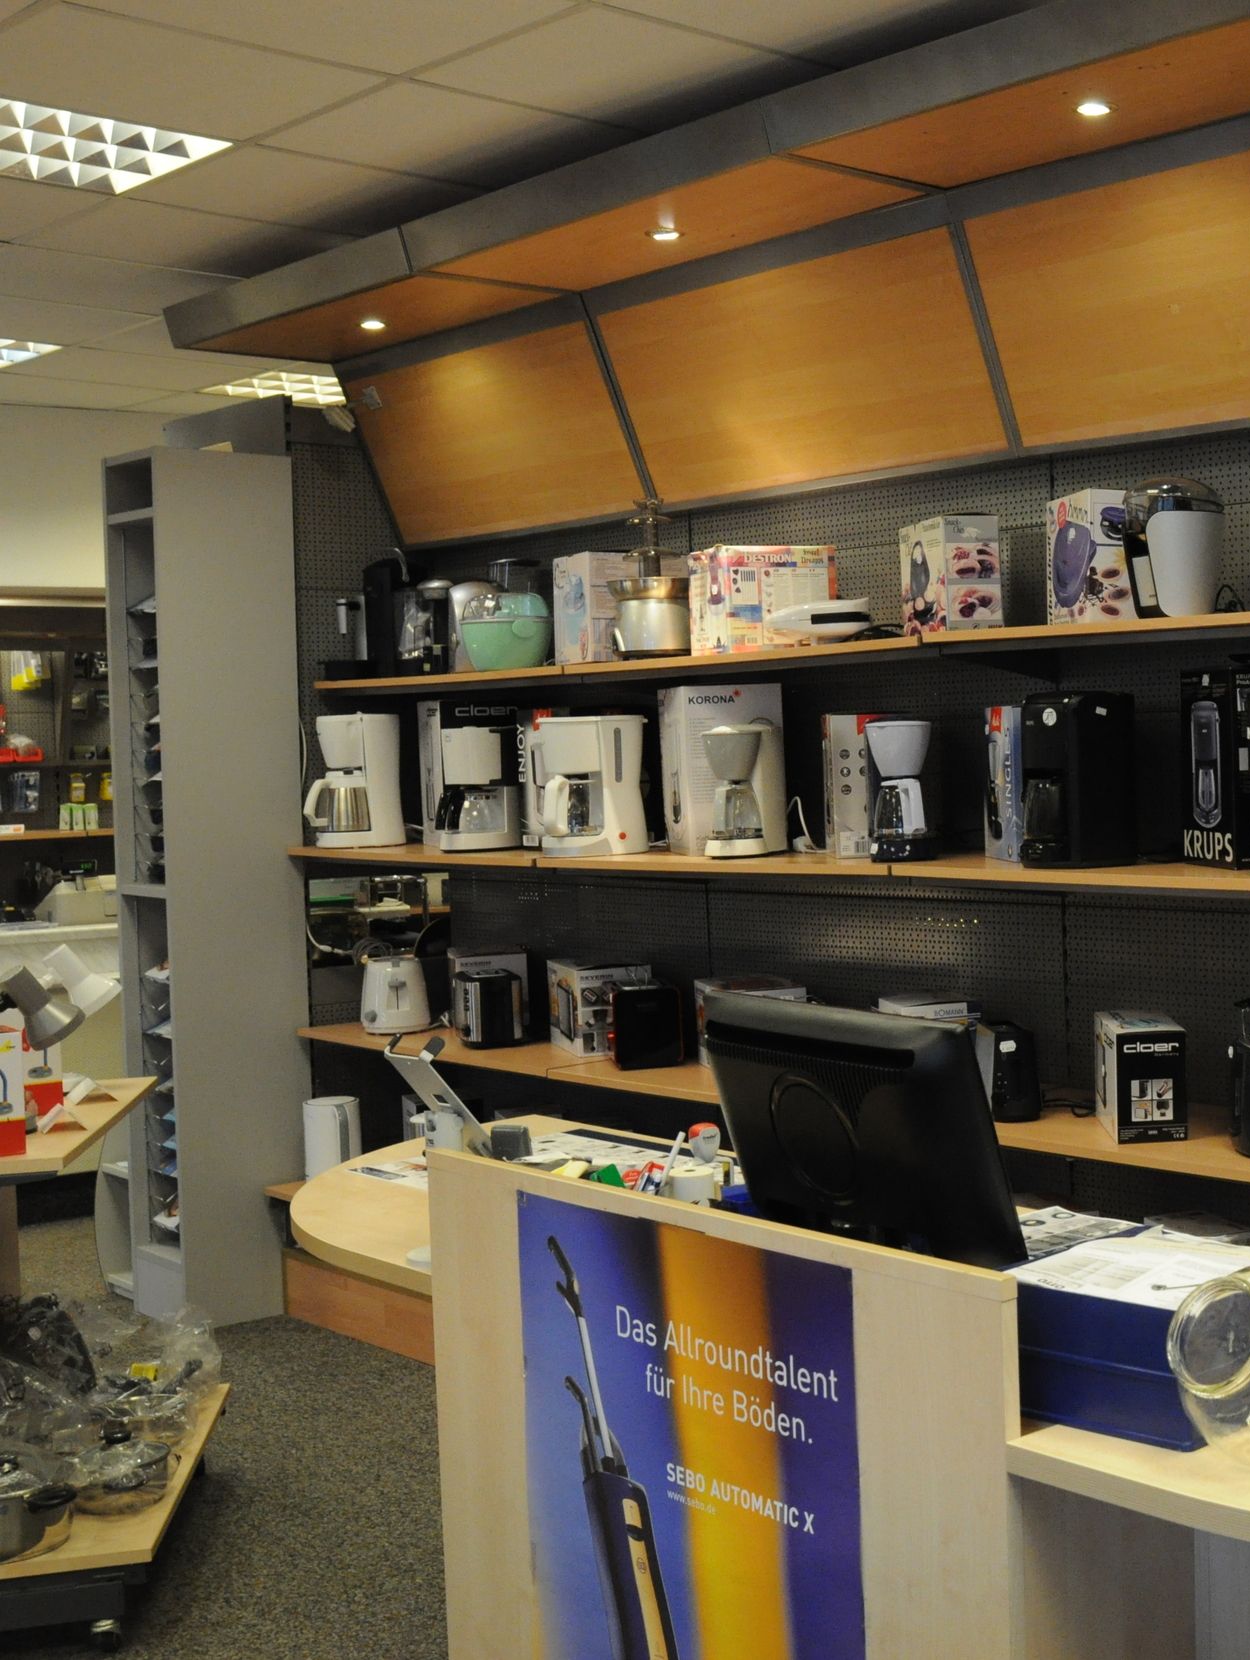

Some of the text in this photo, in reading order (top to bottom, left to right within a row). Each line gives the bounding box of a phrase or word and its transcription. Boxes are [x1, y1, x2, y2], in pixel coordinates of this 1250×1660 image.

[743, 552, 792, 564] DESTRON
[455, 704, 518, 717] cloer
[688, 694, 736, 705] KORONA
[518, 723, 526, 783] ENJOY
[1183, 829, 1233, 862] KRUPS
[1123, 1041, 1180, 1055] cloer
[616, 1304, 838, 1402] Das Allroundtalent
[645, 1363, 813, 1444] für Ihre Böden.
[666, 1463, 815, 1535] SEBO AUTOMATIC X
[667, 1490, 717, 1516] www.sebo.de
